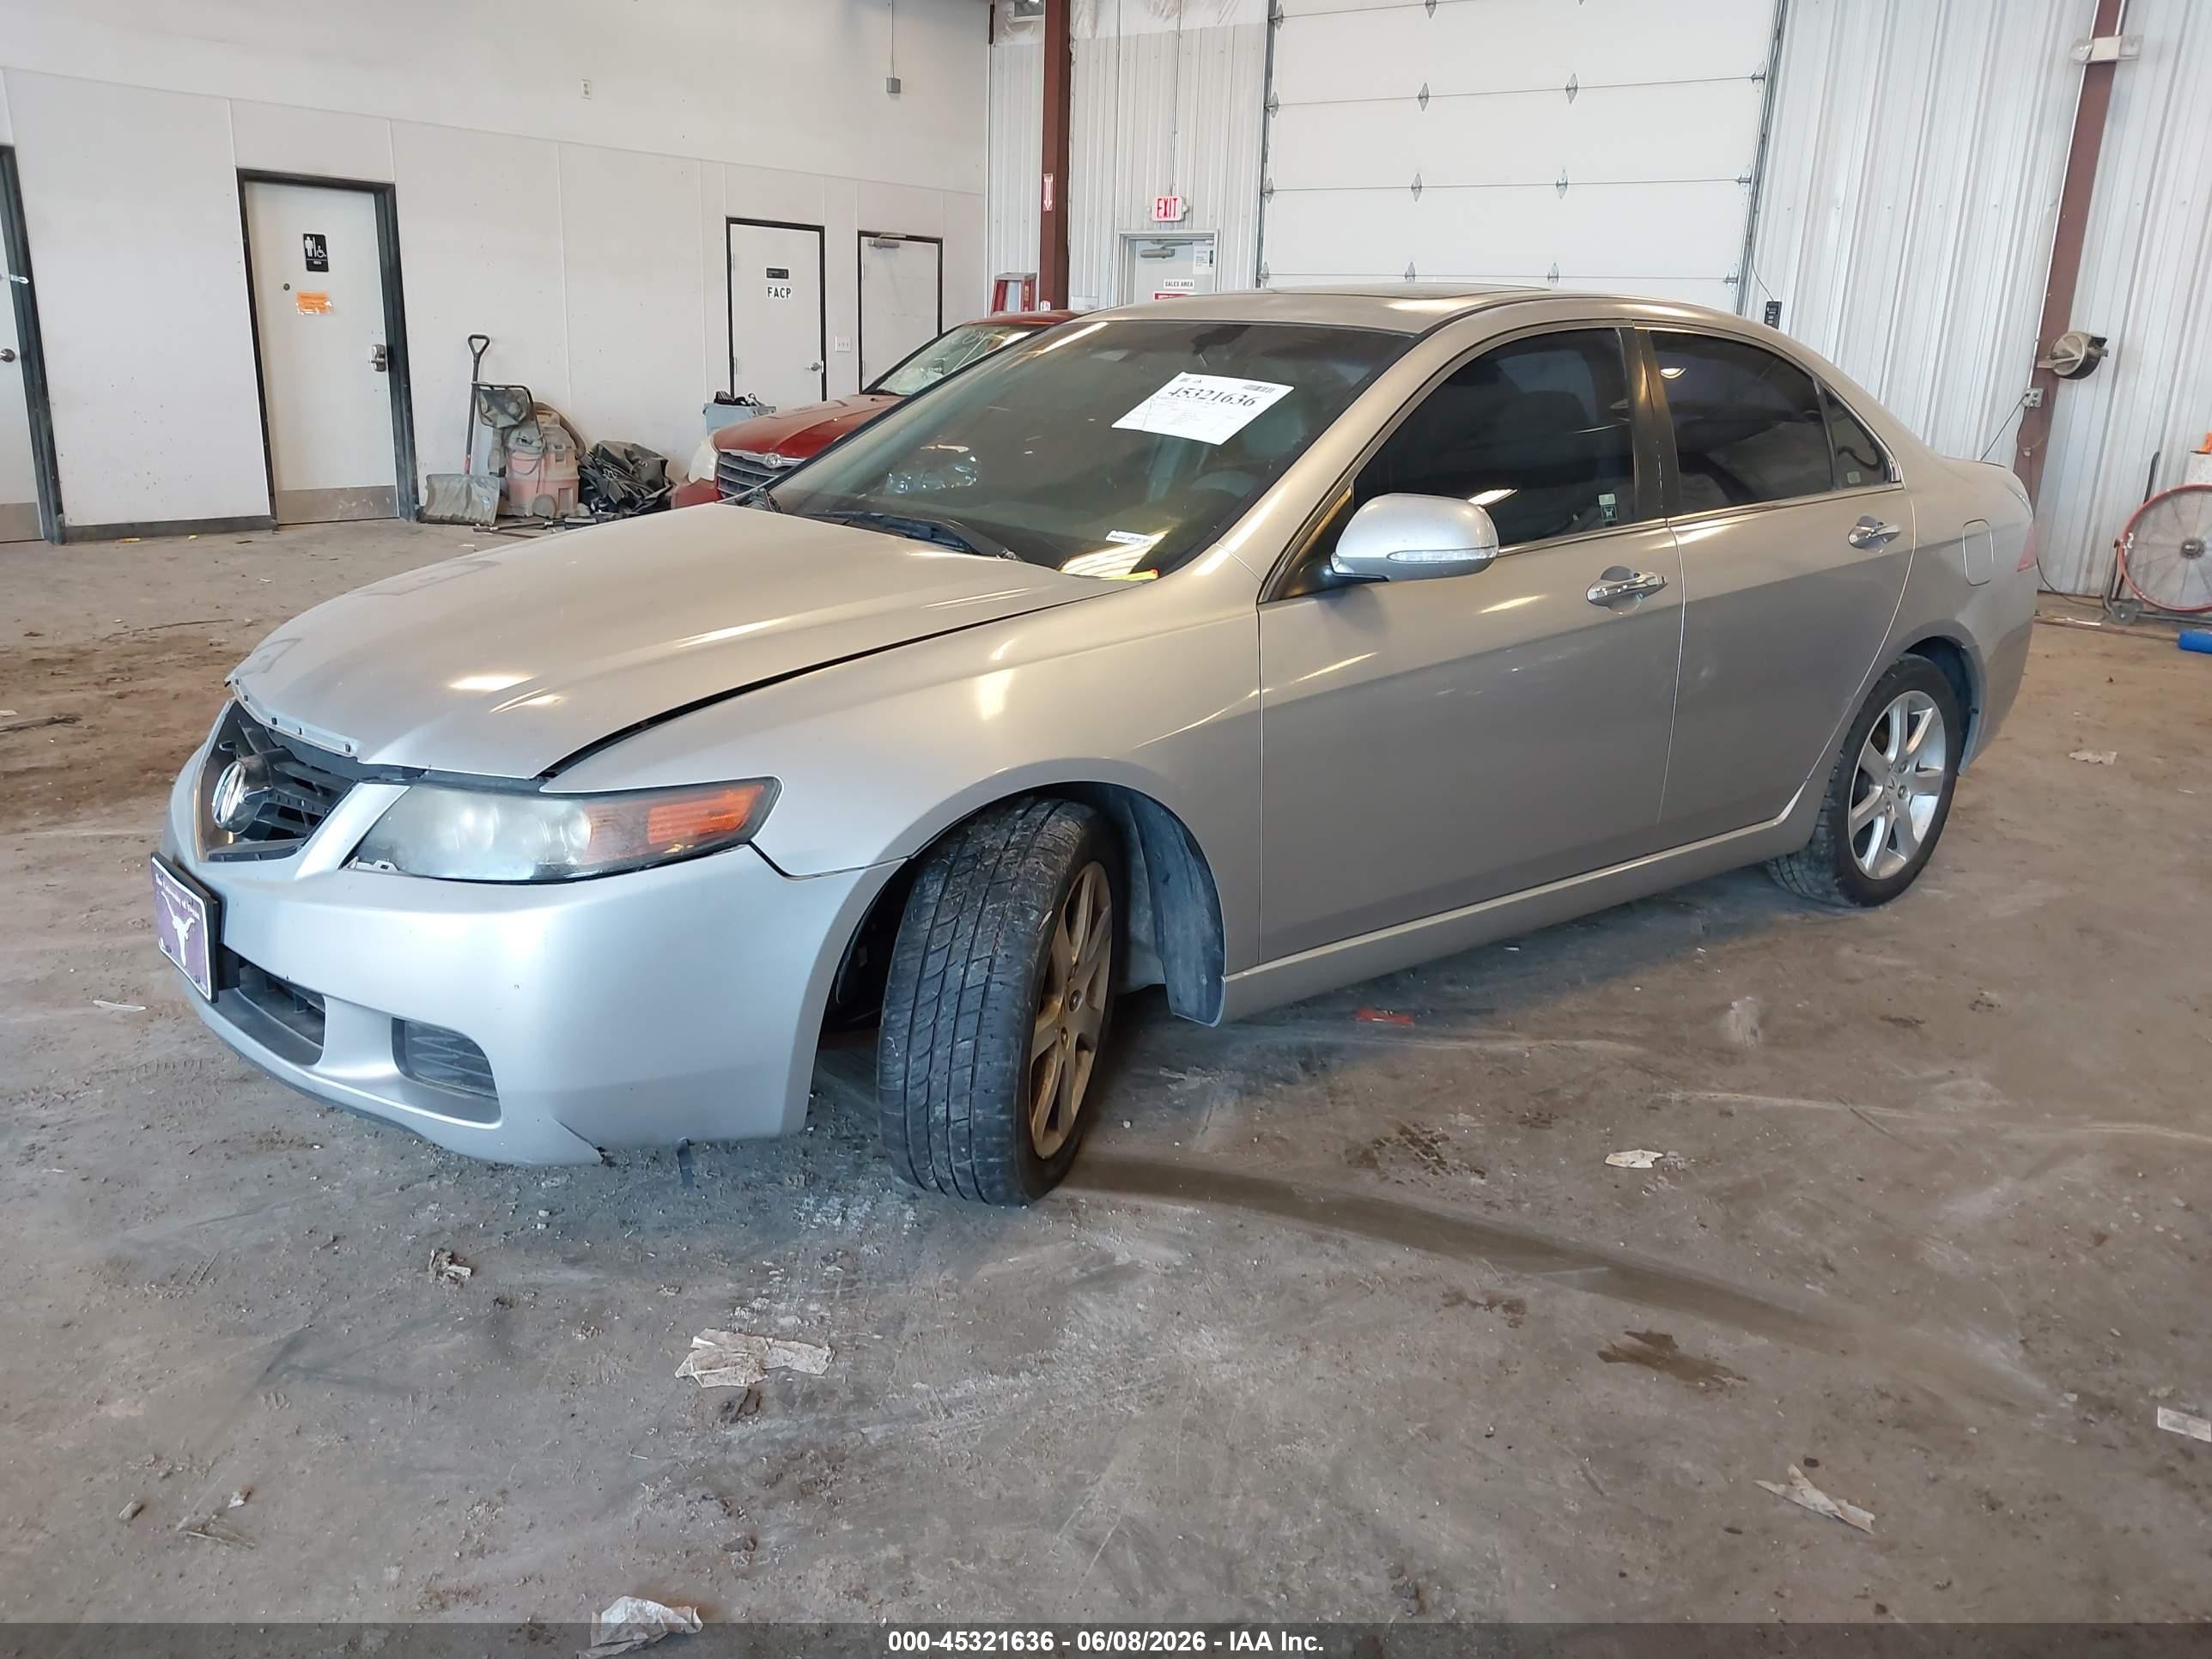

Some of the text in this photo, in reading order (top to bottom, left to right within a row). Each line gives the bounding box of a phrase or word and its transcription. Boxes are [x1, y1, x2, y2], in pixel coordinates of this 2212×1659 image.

[1157, 198, 1178, 218] EXIT
[767, 286, 792, 299] FACP
[1168, 386, 1261, 407] 45321636
